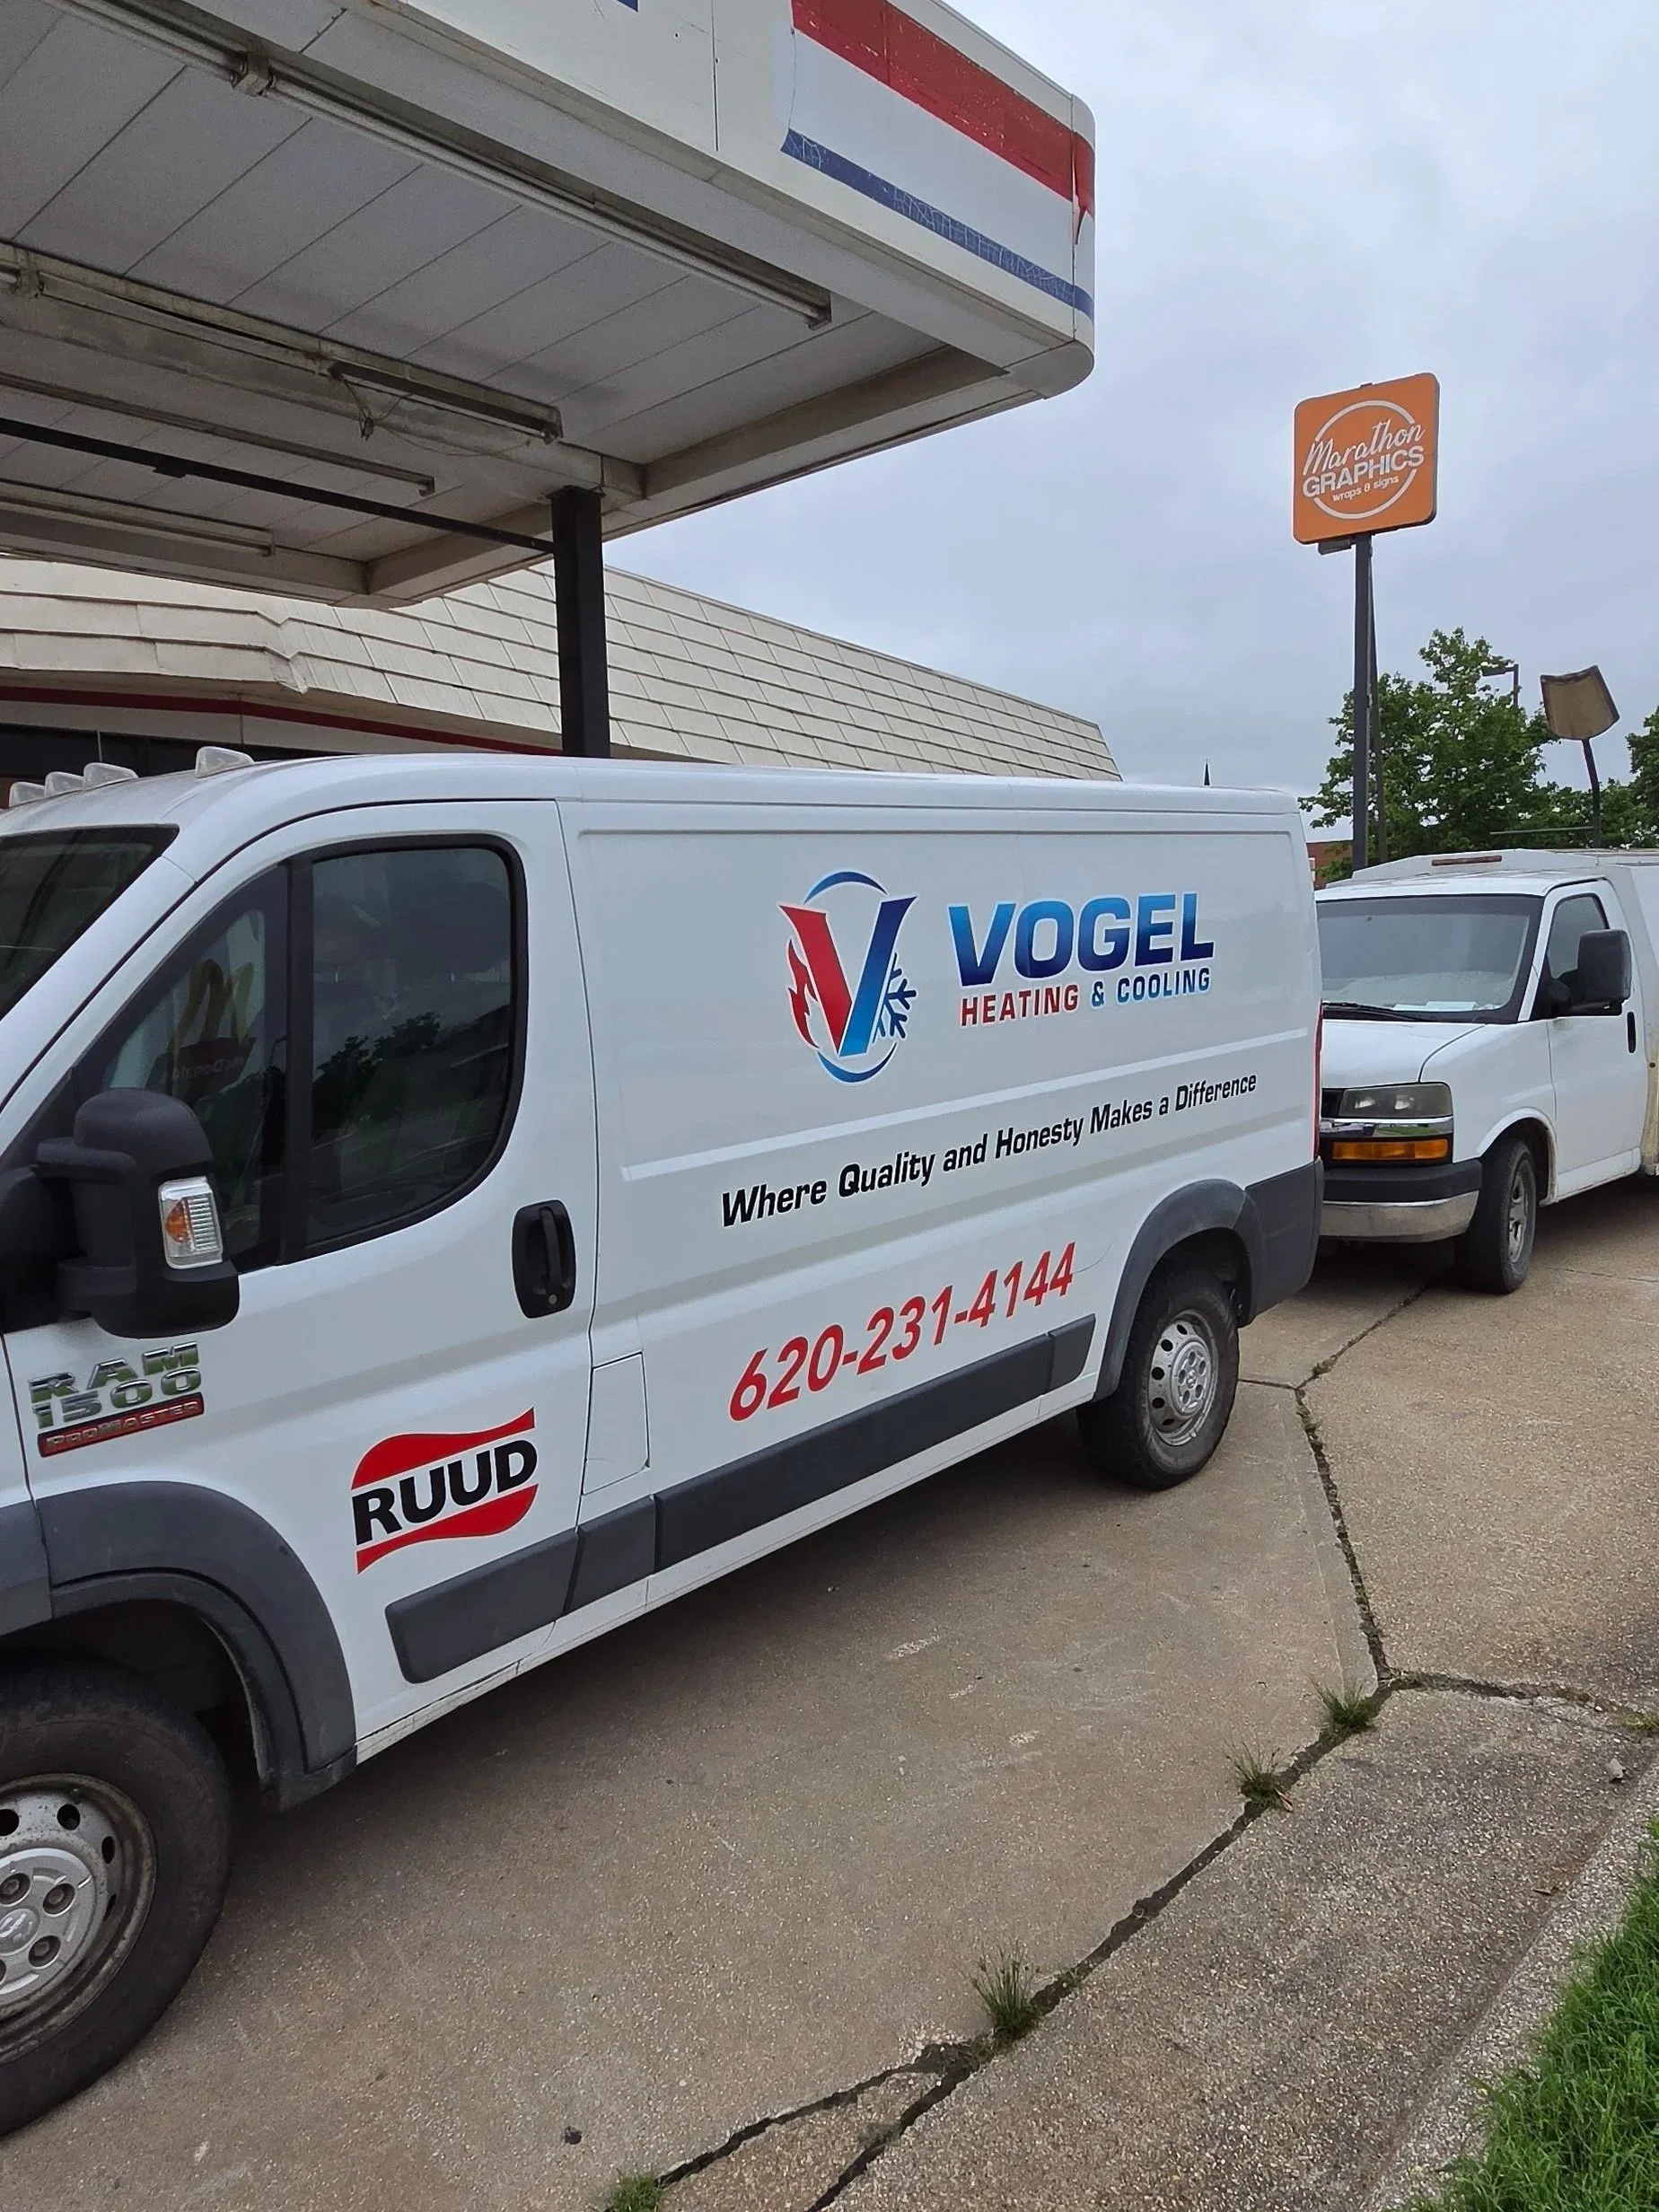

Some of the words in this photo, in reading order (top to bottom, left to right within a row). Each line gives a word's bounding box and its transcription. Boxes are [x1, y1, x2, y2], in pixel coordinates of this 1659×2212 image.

[1303, 418, 1426, 476] Marathon
[1303, 445, 1425, 497] GRAPHICS
[1332, 487, 1362, 503] wraps
[1373, 475, 1400, 489] signs
[947, 892, 1215, 988] VOGEL
[960, 984, 1080, 1027] HEATING
[1090, 980, 1106, 1008] &
[1116, 967, 1211, 1005] COOLING
[722, 1182, 827, 1228] Where
[838, 1152, 936, 1198] Quality
[942, 1134, 988, 1173] and
[995, 1114, 1084, 1159] Honesty
[1089, 1100, 1153, 1137] Makes
[1158, 1095, 1169, 1116] a
[1174, 1074, 1258, 1112] Difference
[727, 1241, 1076, 1423] 620-231-4144
[28, 1340, 199, 1404] RAM
[31, 1367, 202, 1429] 1500
[46, 1400, 199, 1450] PROMASTER
[351, 1438, 539, 1546] RUUD
